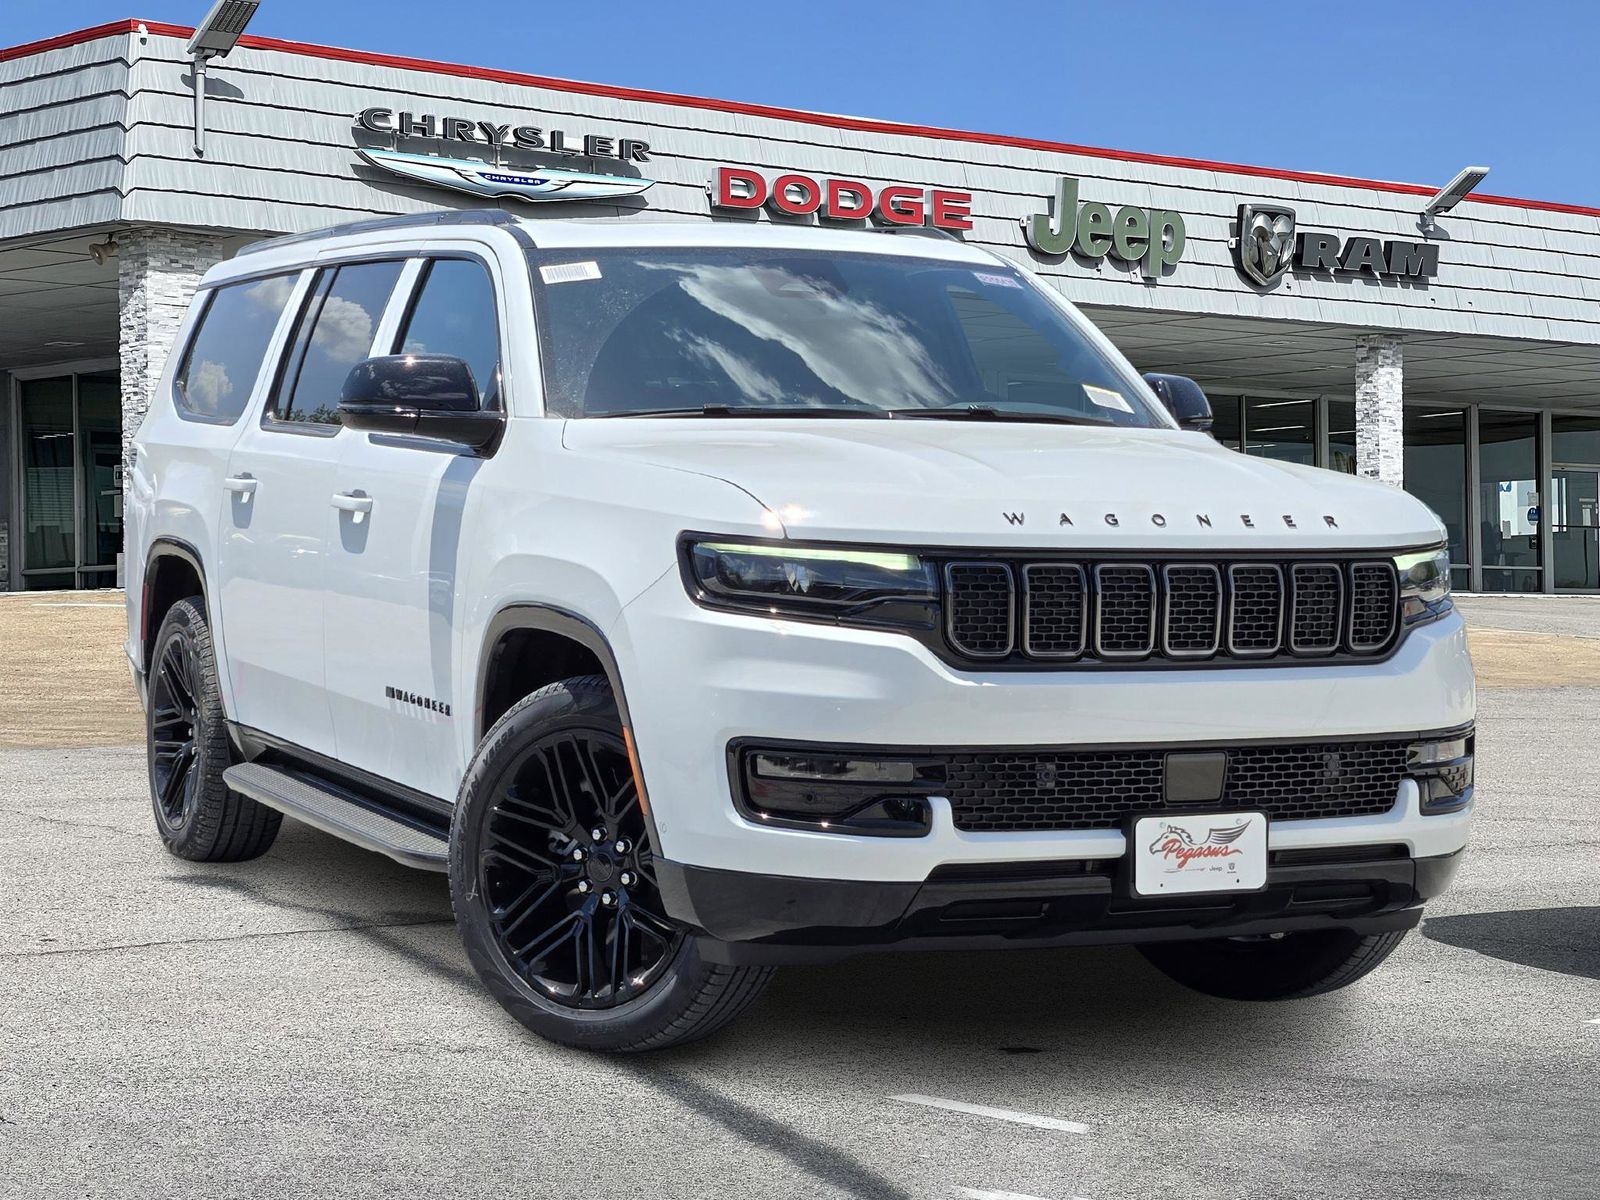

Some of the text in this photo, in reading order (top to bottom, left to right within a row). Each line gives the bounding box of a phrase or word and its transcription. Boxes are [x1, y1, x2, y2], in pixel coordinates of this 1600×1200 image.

[358, 106, 652, 162] CHRYSLER
[484, 174, 541, 185] CHRYSLER
[713, 166, 974, 230] DODGE
[1027, 176, 1187, 279] Jeep
[1299, 231, 1440, 277] RAM
[1002, 511, 1340, 529] WAGONEER
[395, 688, 451, 716] WAGONEER
[1161, 838, 1243, 869] Pegasus
